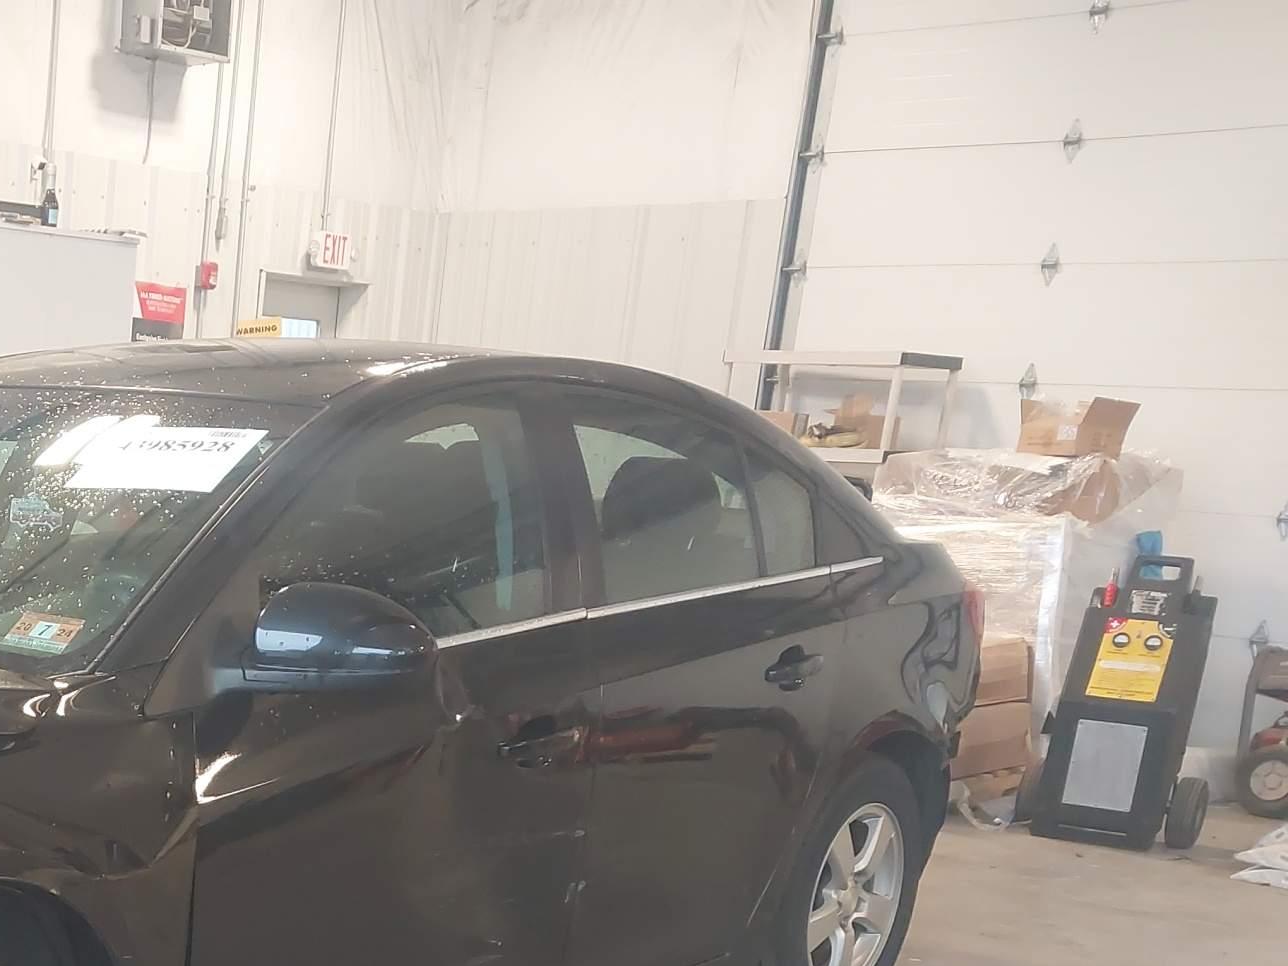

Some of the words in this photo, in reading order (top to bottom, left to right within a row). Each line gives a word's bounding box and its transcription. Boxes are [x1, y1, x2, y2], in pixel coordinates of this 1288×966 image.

[322, 232, 348, 265] EXIT
[236, 323, 278, 336] WARNING
[38, 623, 54, 636] 7
